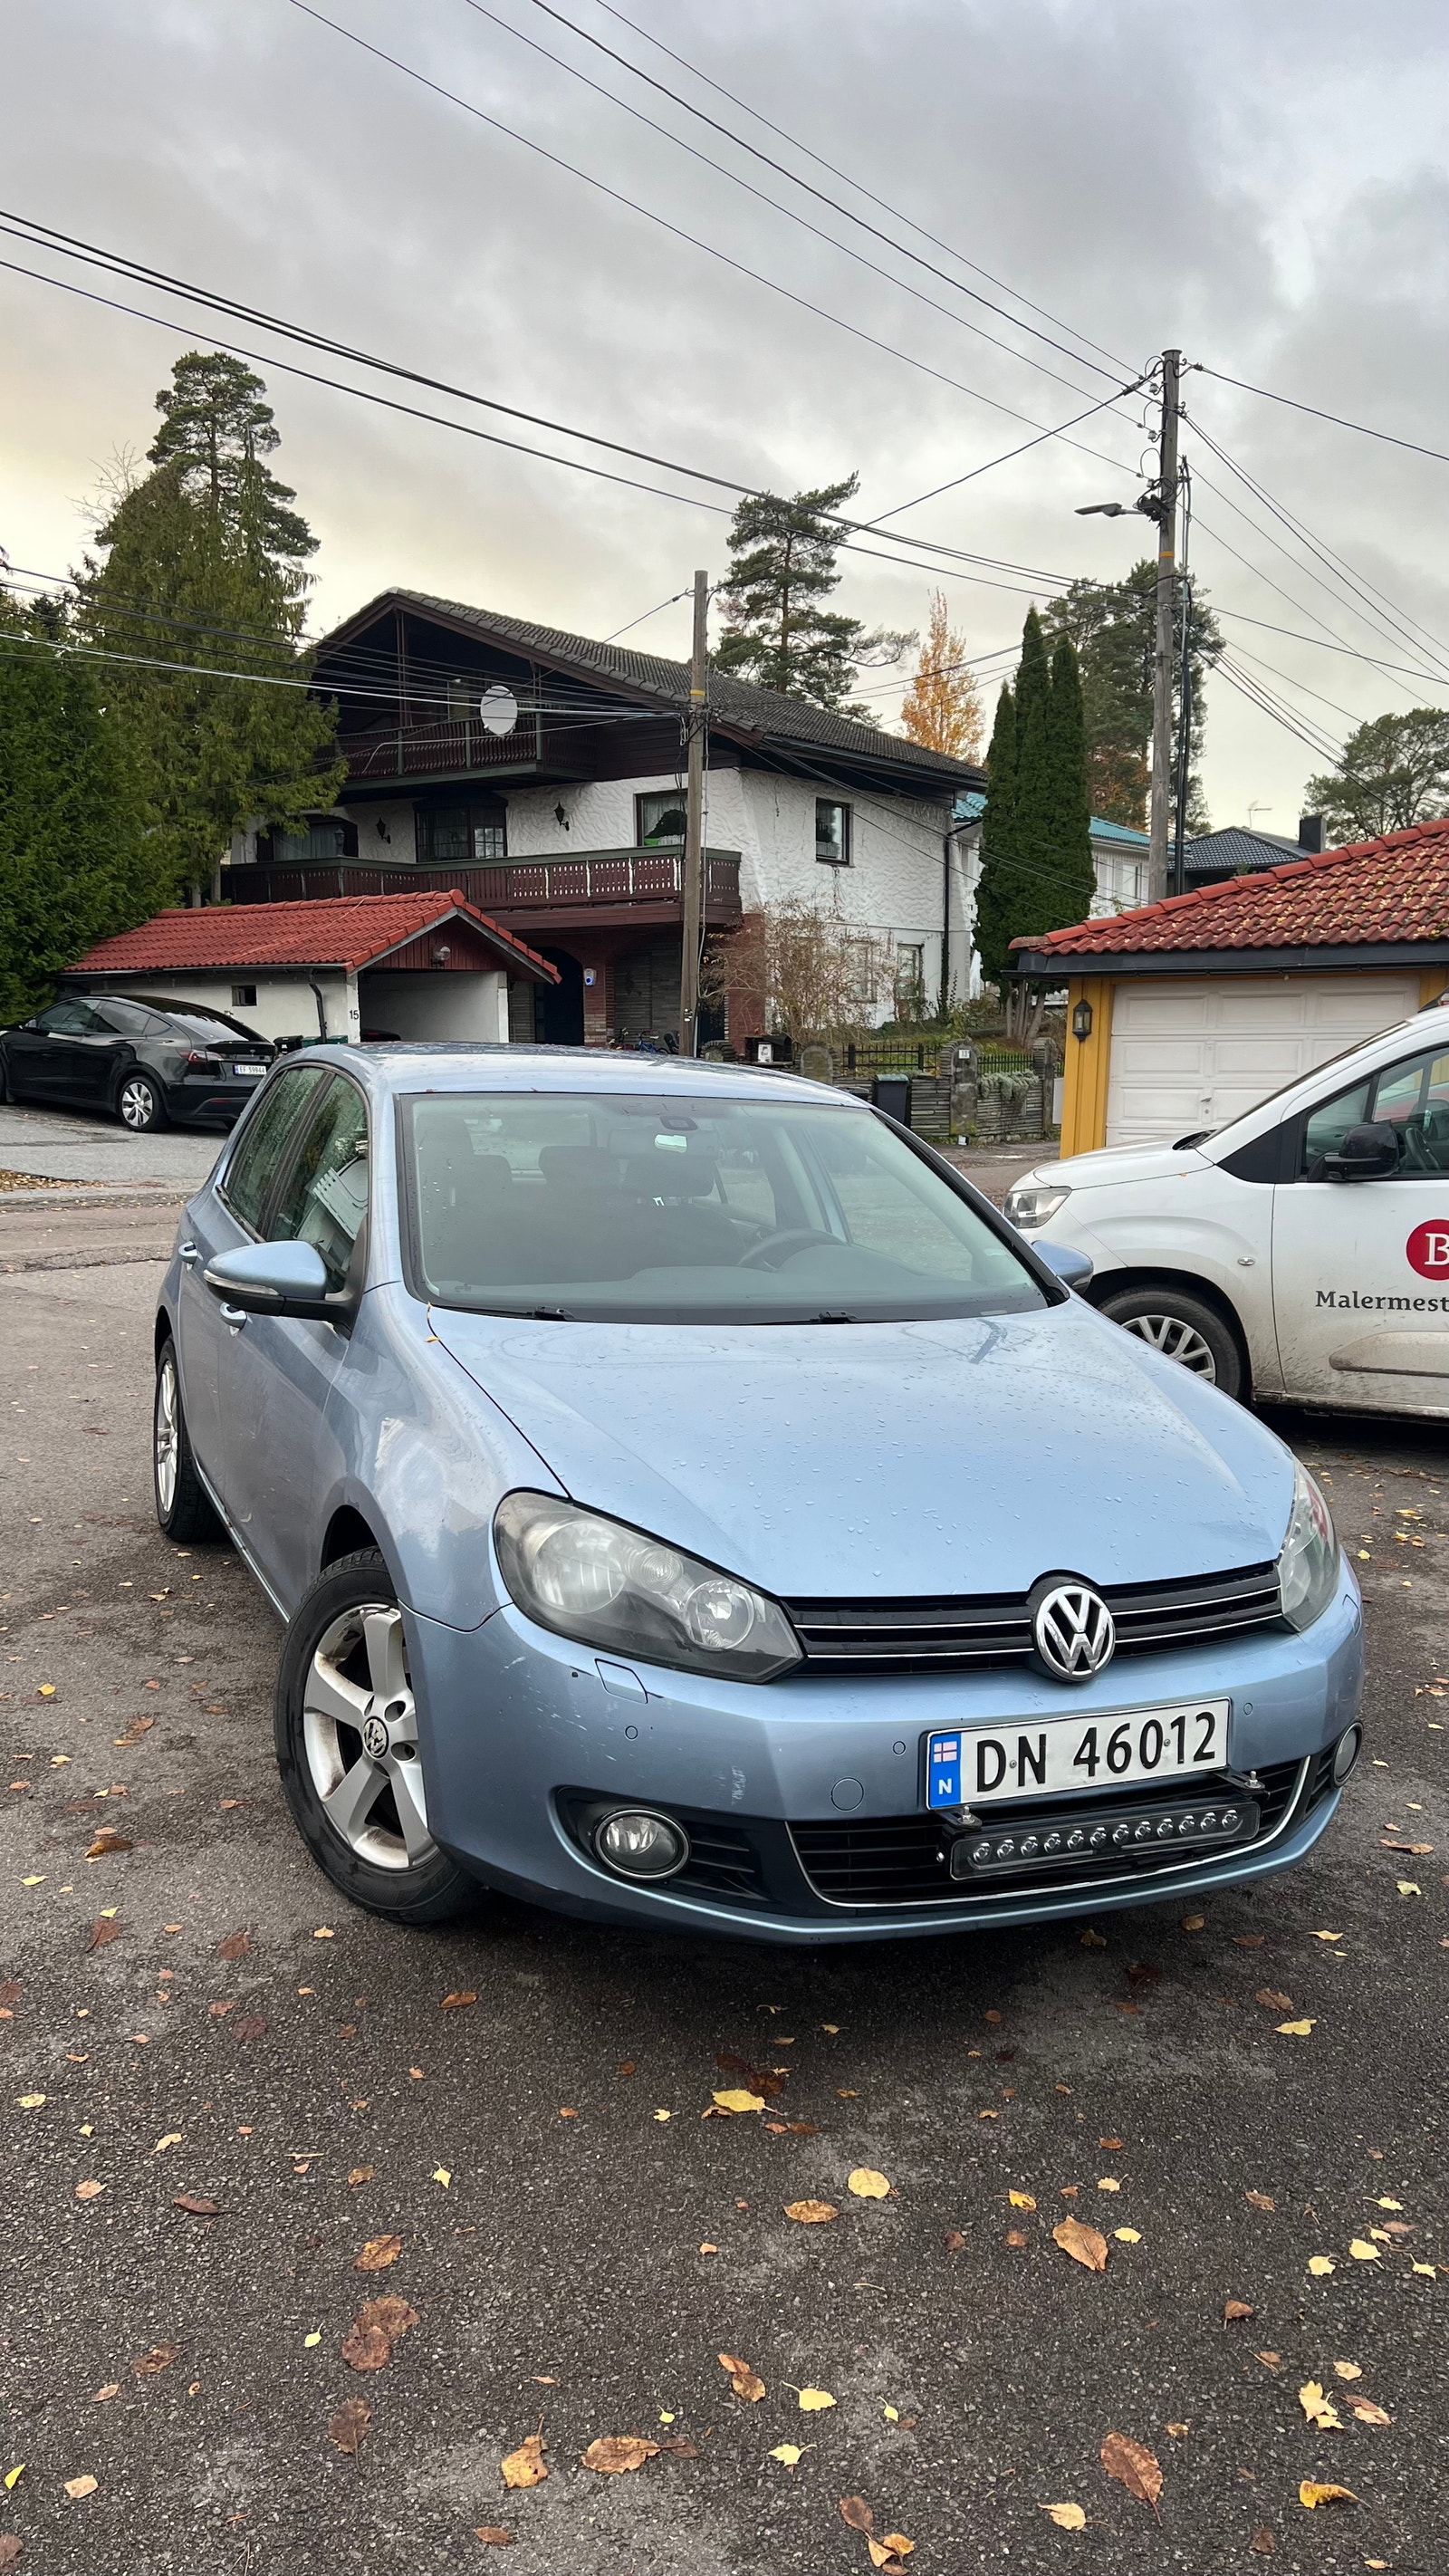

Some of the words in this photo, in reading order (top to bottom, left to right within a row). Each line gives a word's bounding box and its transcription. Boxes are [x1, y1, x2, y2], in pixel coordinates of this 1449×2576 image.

[349, 1009, 360, 1020] 15
[239, 1065, 246, 1073] EF
[248, 1066, 265, 1074] 59944
[1424, 1232, 1449, 1266] B
[1315, 1290, 1449, 1312] Malermest
[975, 1733, 1047, 1793] DN
[1072, 1711, 1216, 1778] 46012
[938, 1778, 953, 1795] N
